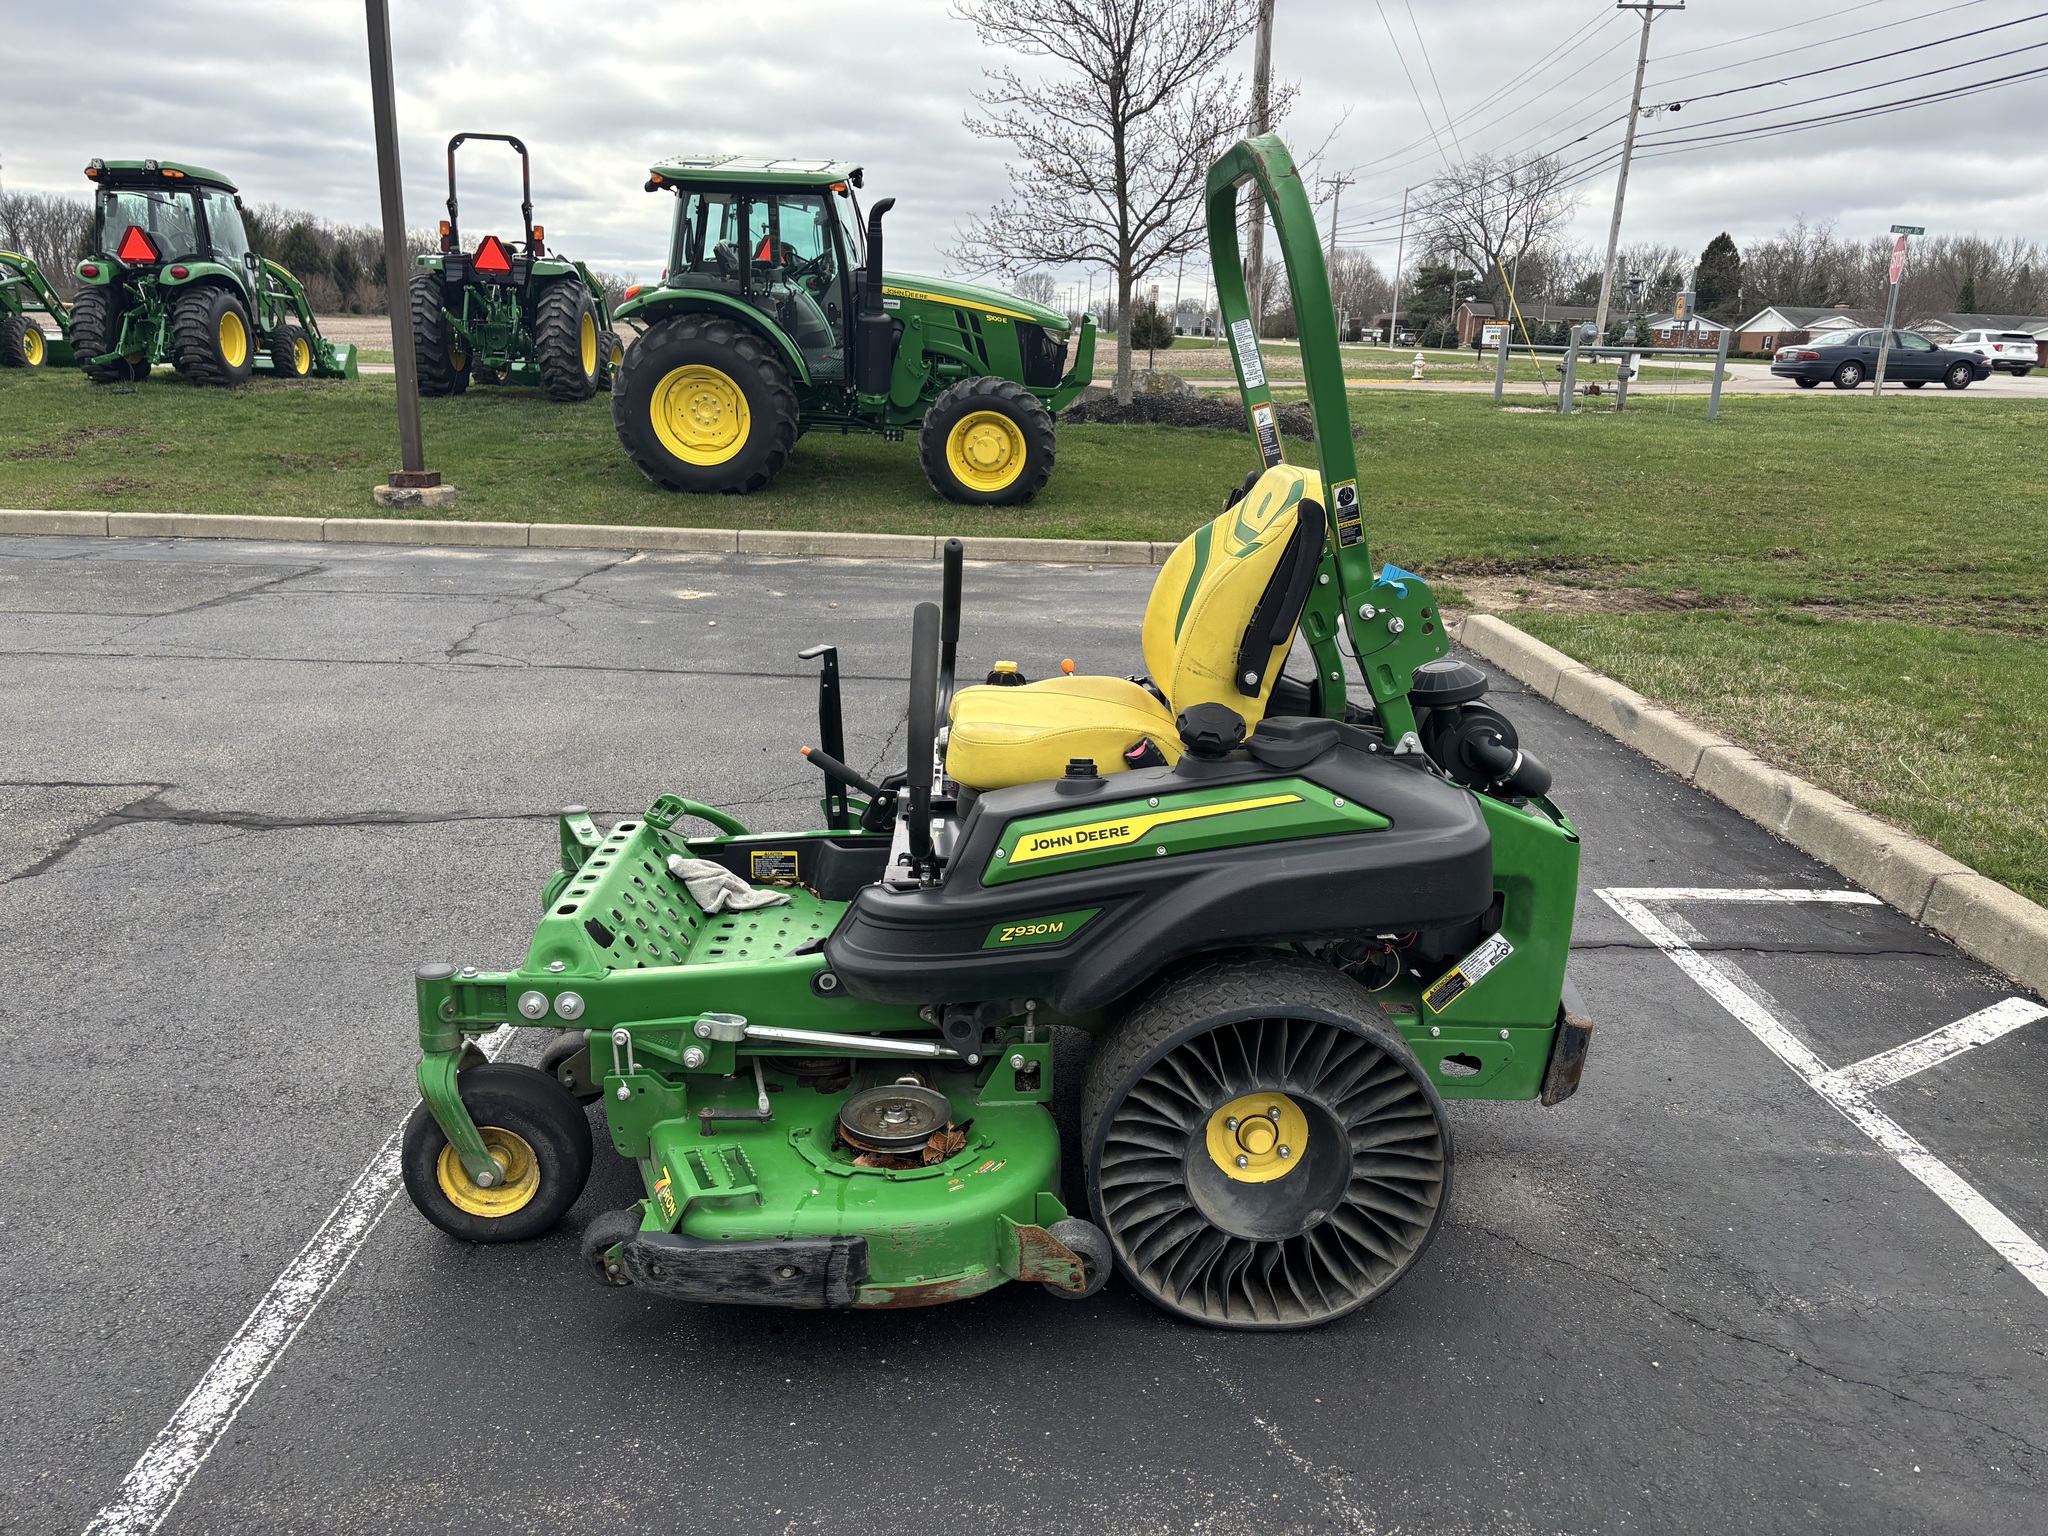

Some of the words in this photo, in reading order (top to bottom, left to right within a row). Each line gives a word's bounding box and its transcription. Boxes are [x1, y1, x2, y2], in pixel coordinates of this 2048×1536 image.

[1892, 250, 1904, 268] STOP
[886, 288, 904, 297] JOHN
[905, 291, 928, 299] DEERE
[1030, 834, 1073, 851] JOHN
[1076, 826, 1130, 843] DEERE
[999, 921, 1064, 941] Z930M
[504, 1111, 561, 1170] CARLISLE
